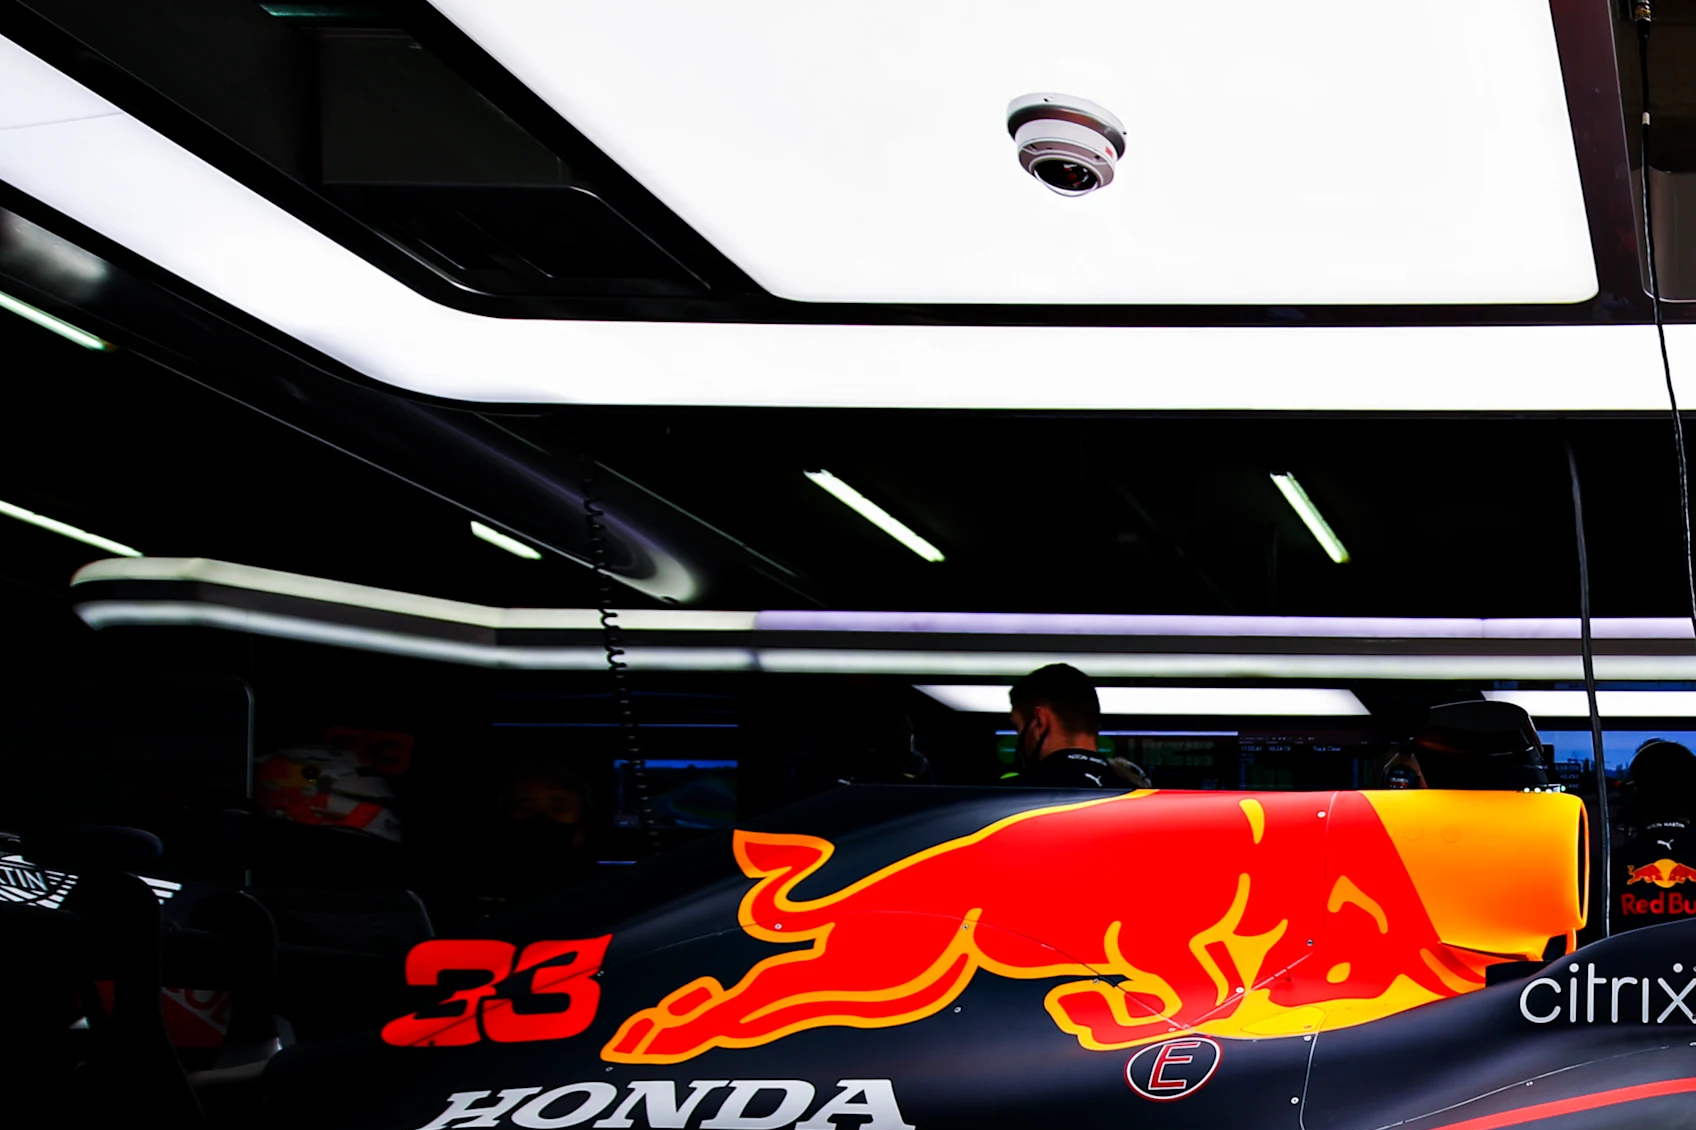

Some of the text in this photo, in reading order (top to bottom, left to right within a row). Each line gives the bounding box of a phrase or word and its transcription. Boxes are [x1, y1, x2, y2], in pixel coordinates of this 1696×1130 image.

[0, 867, 49, 891] TIN
[381, 933, 613, 1046] 33
[1148, 1041, 1200, 1090] E
